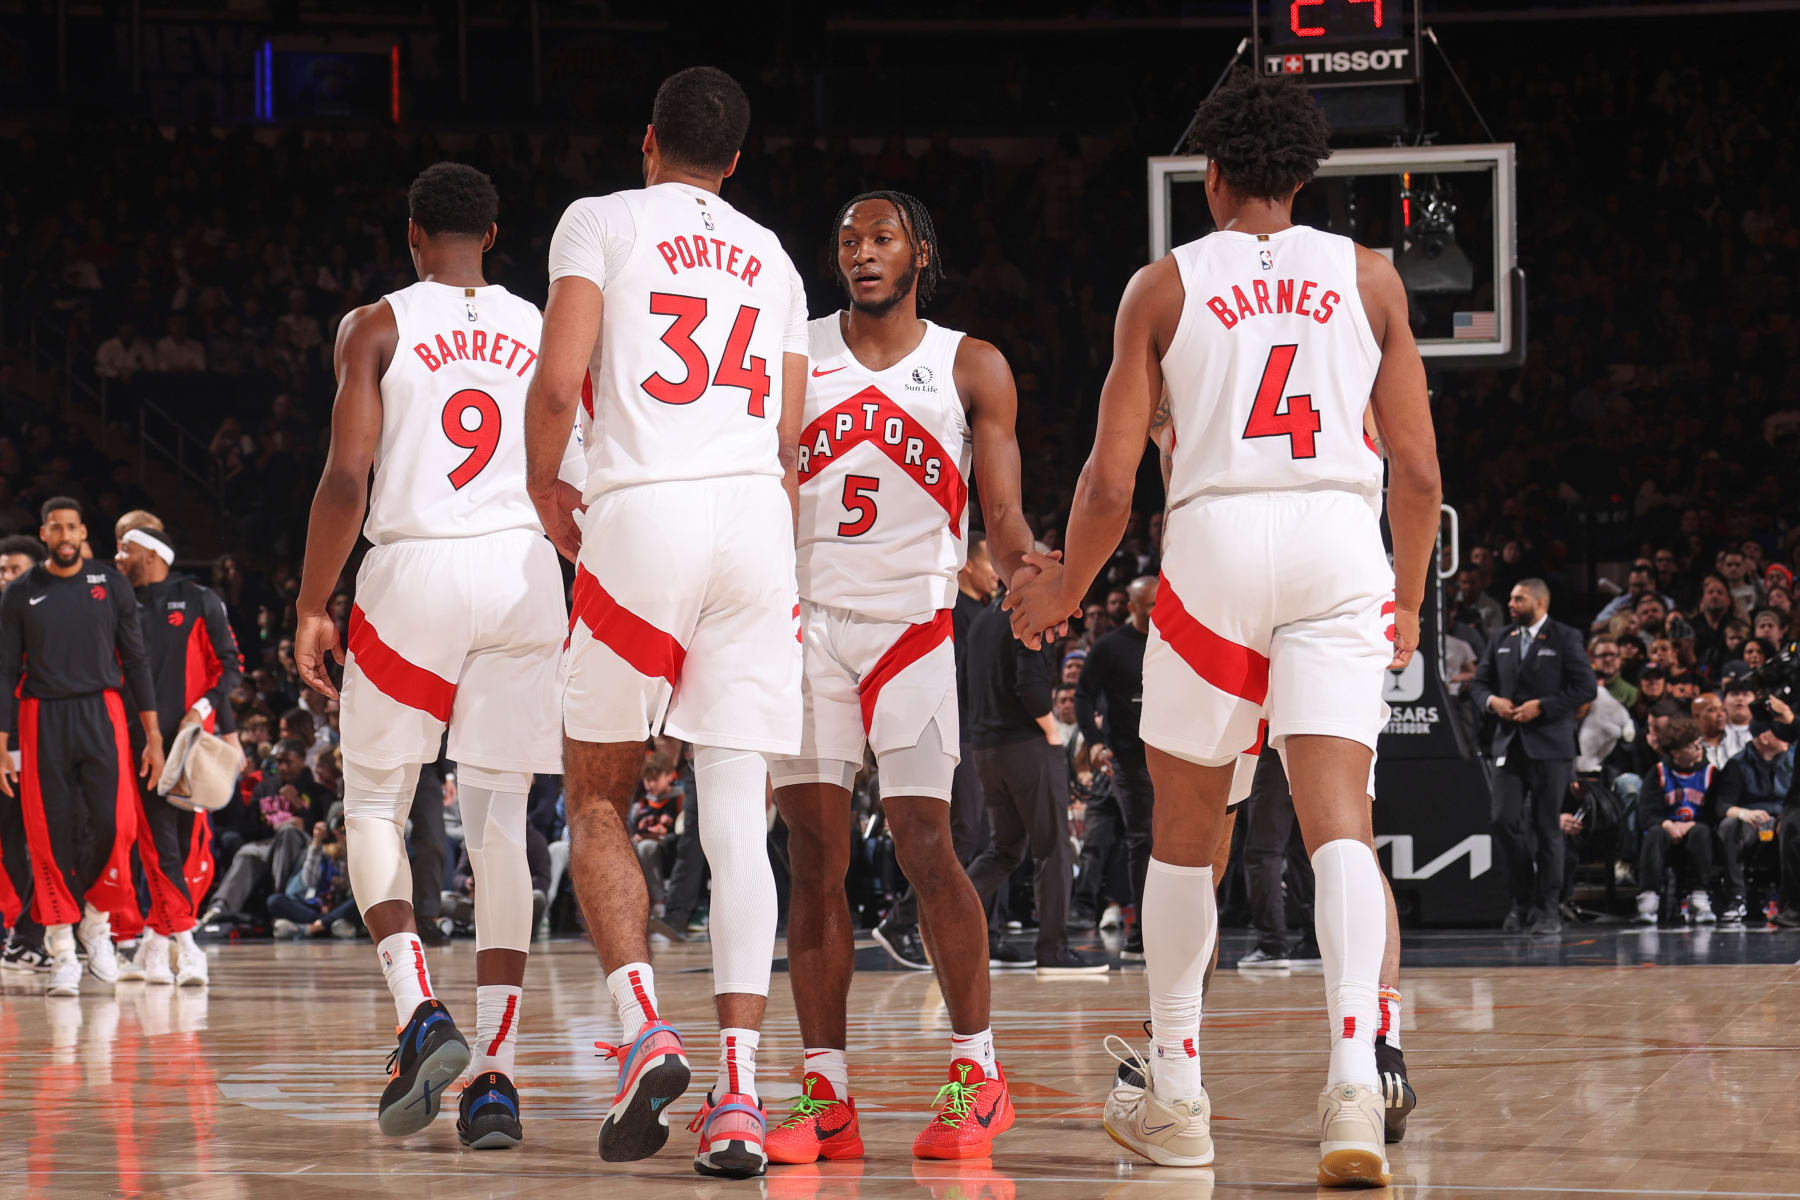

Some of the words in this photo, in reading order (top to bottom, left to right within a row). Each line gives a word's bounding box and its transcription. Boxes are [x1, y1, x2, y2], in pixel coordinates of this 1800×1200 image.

[1304, 49, 1409, 73] TISSOT
[656, 234, 762, 288] PORTER
[1206, 279, 1341, 330] BARNES
[413, 329, 538, 378] BARRETT
[640, 291, 771, 419] 34
[904, 383, 921, 392] Sun
[922, 385, 938, 394] Life
[1242, 344, 1321, 460] 4
[441, 388, 502, 491] 9
[797, 402, 942, 486] RAPTORS
[837, 474, 880, 538] 5
[1390, 706, 1439, 723] SARS
[489, 1074, 496, 1084] 9
